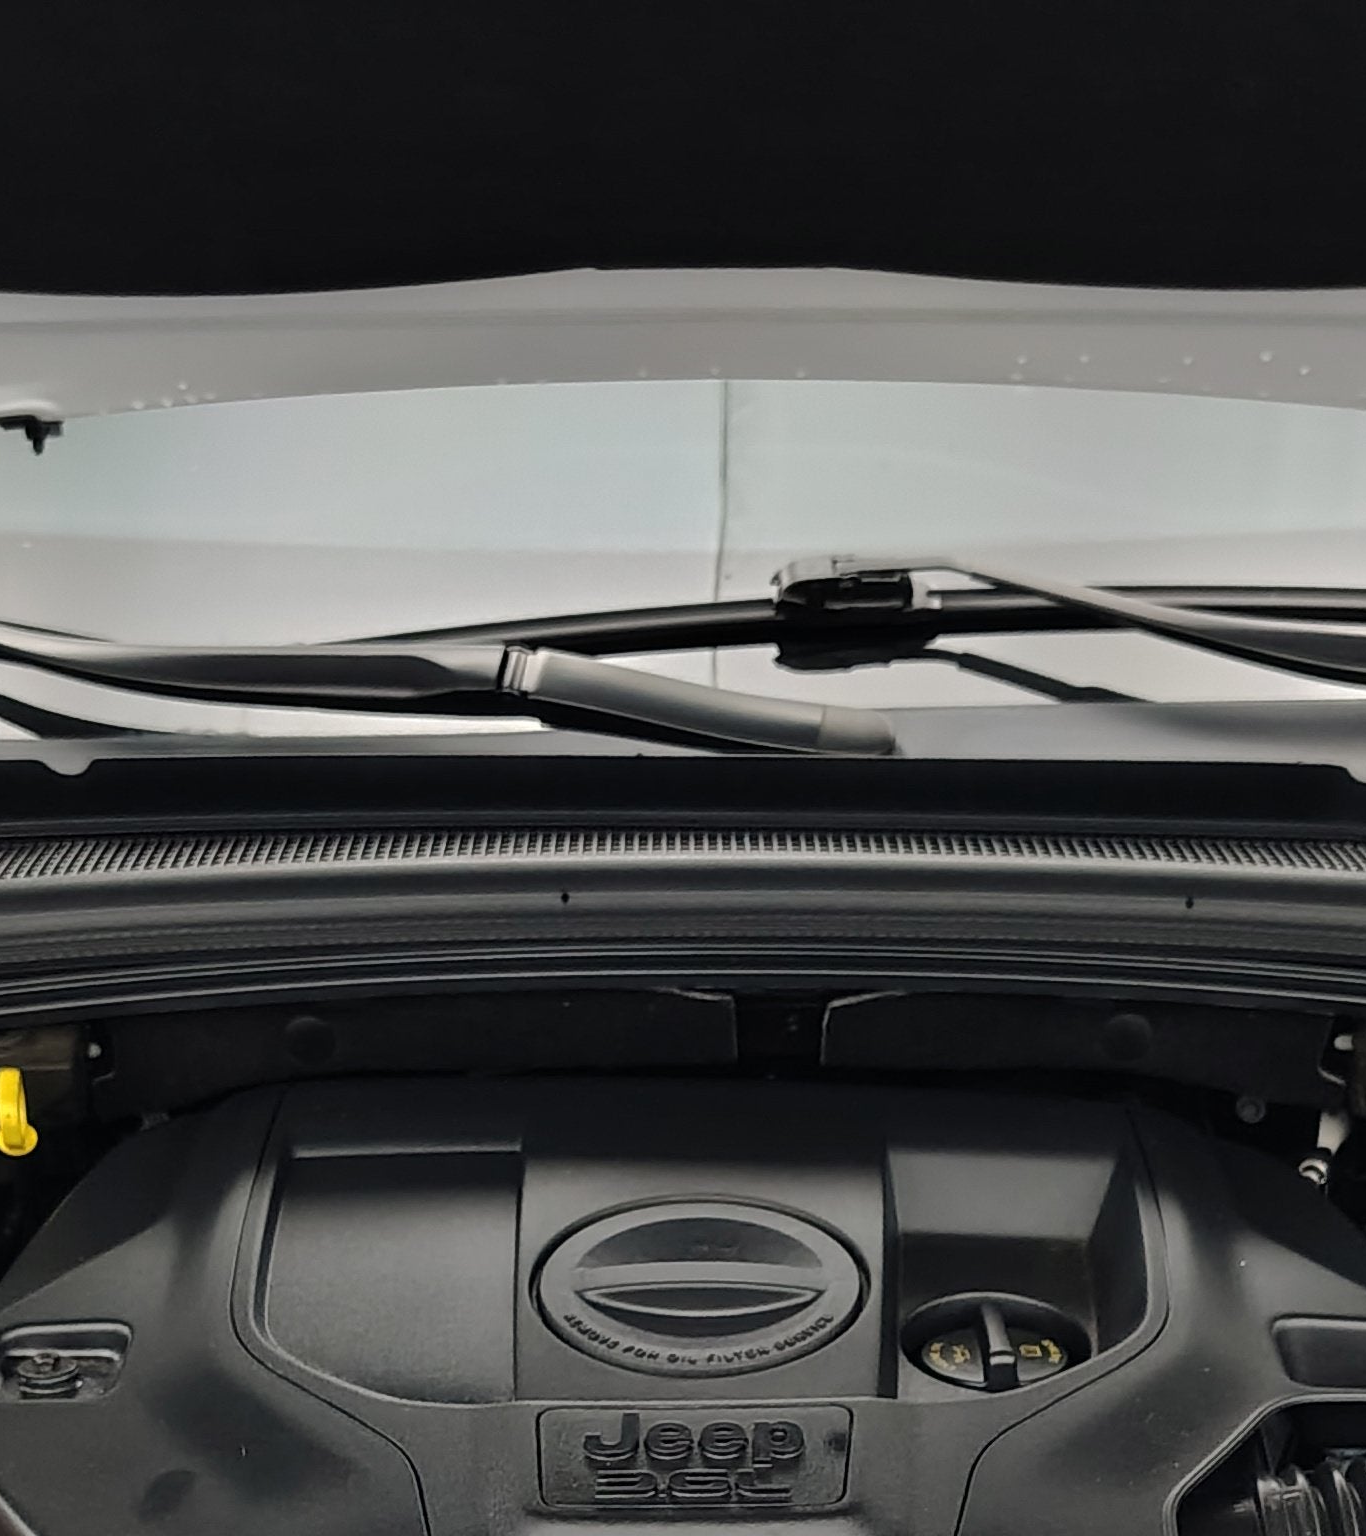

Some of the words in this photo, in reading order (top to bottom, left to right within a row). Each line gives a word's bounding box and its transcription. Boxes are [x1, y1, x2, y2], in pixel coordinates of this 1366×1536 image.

[621, 1345, 661, 1361] FOR
[666, 1353, 698, 1365] OIL
[705, 1346, 771, 1363] FILTER
[582, 1412, 805, 1468] Jeep
